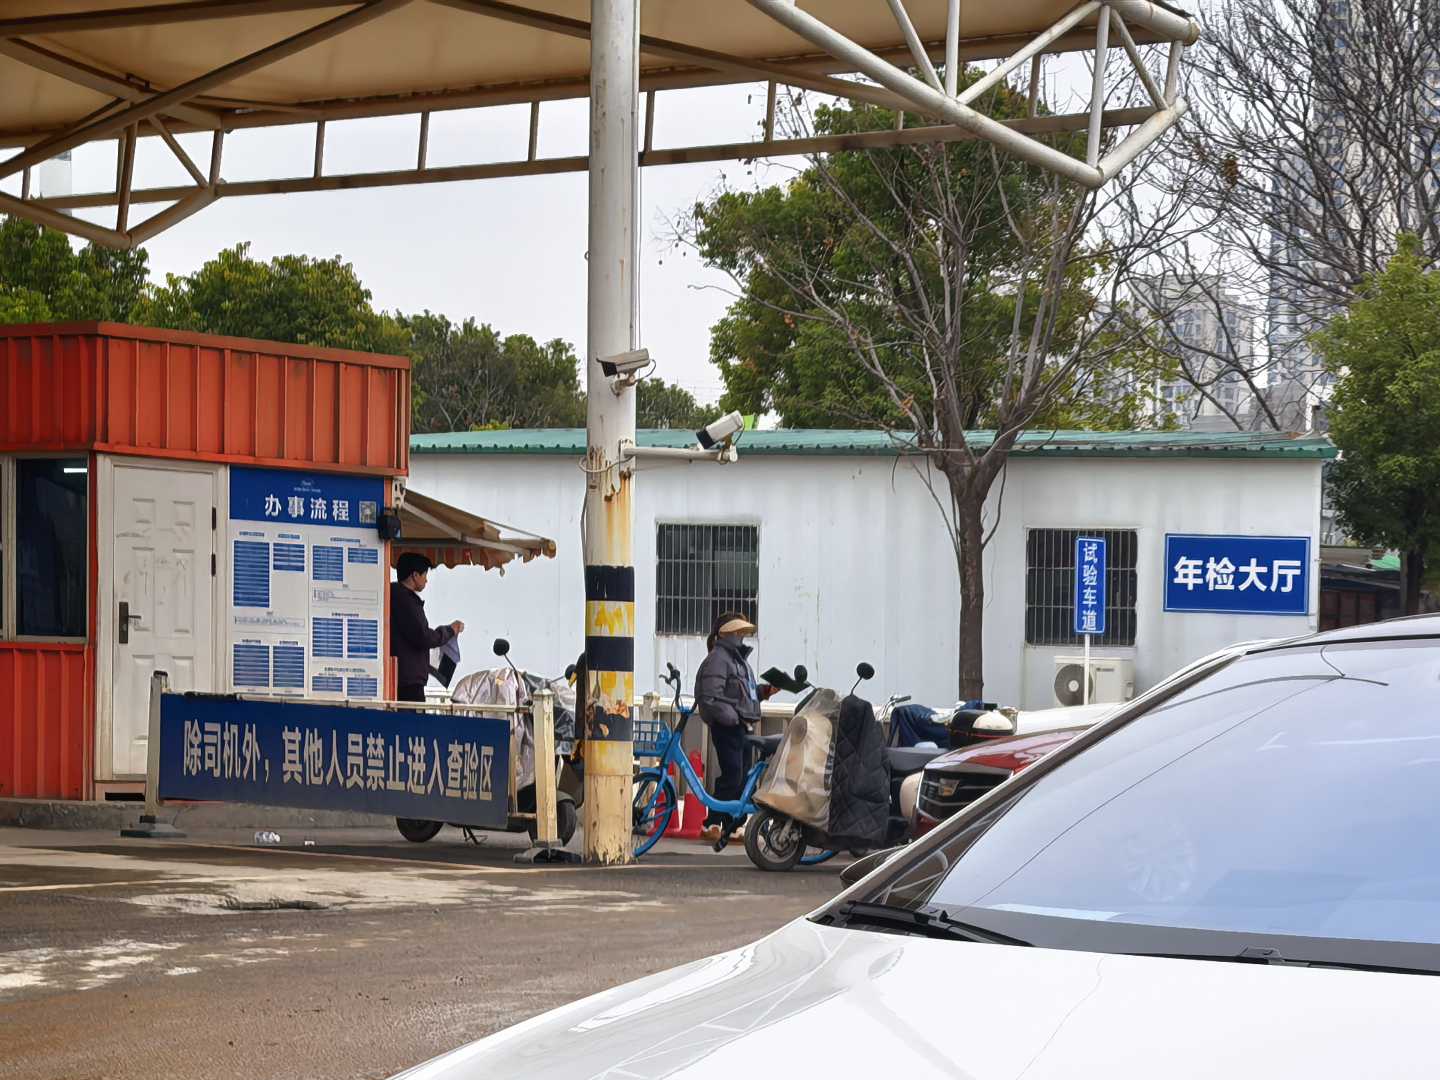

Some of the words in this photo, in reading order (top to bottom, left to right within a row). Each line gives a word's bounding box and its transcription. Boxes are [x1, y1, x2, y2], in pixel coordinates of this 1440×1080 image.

[264, 493, 350, 521] 办事流程
[1082, 542, 1098, 632] 试验车道
[1173, 556, 1302, 593] 年检大厅
[183, 719, 494, 800] 除司机外，其他人员禁止进入查验区
